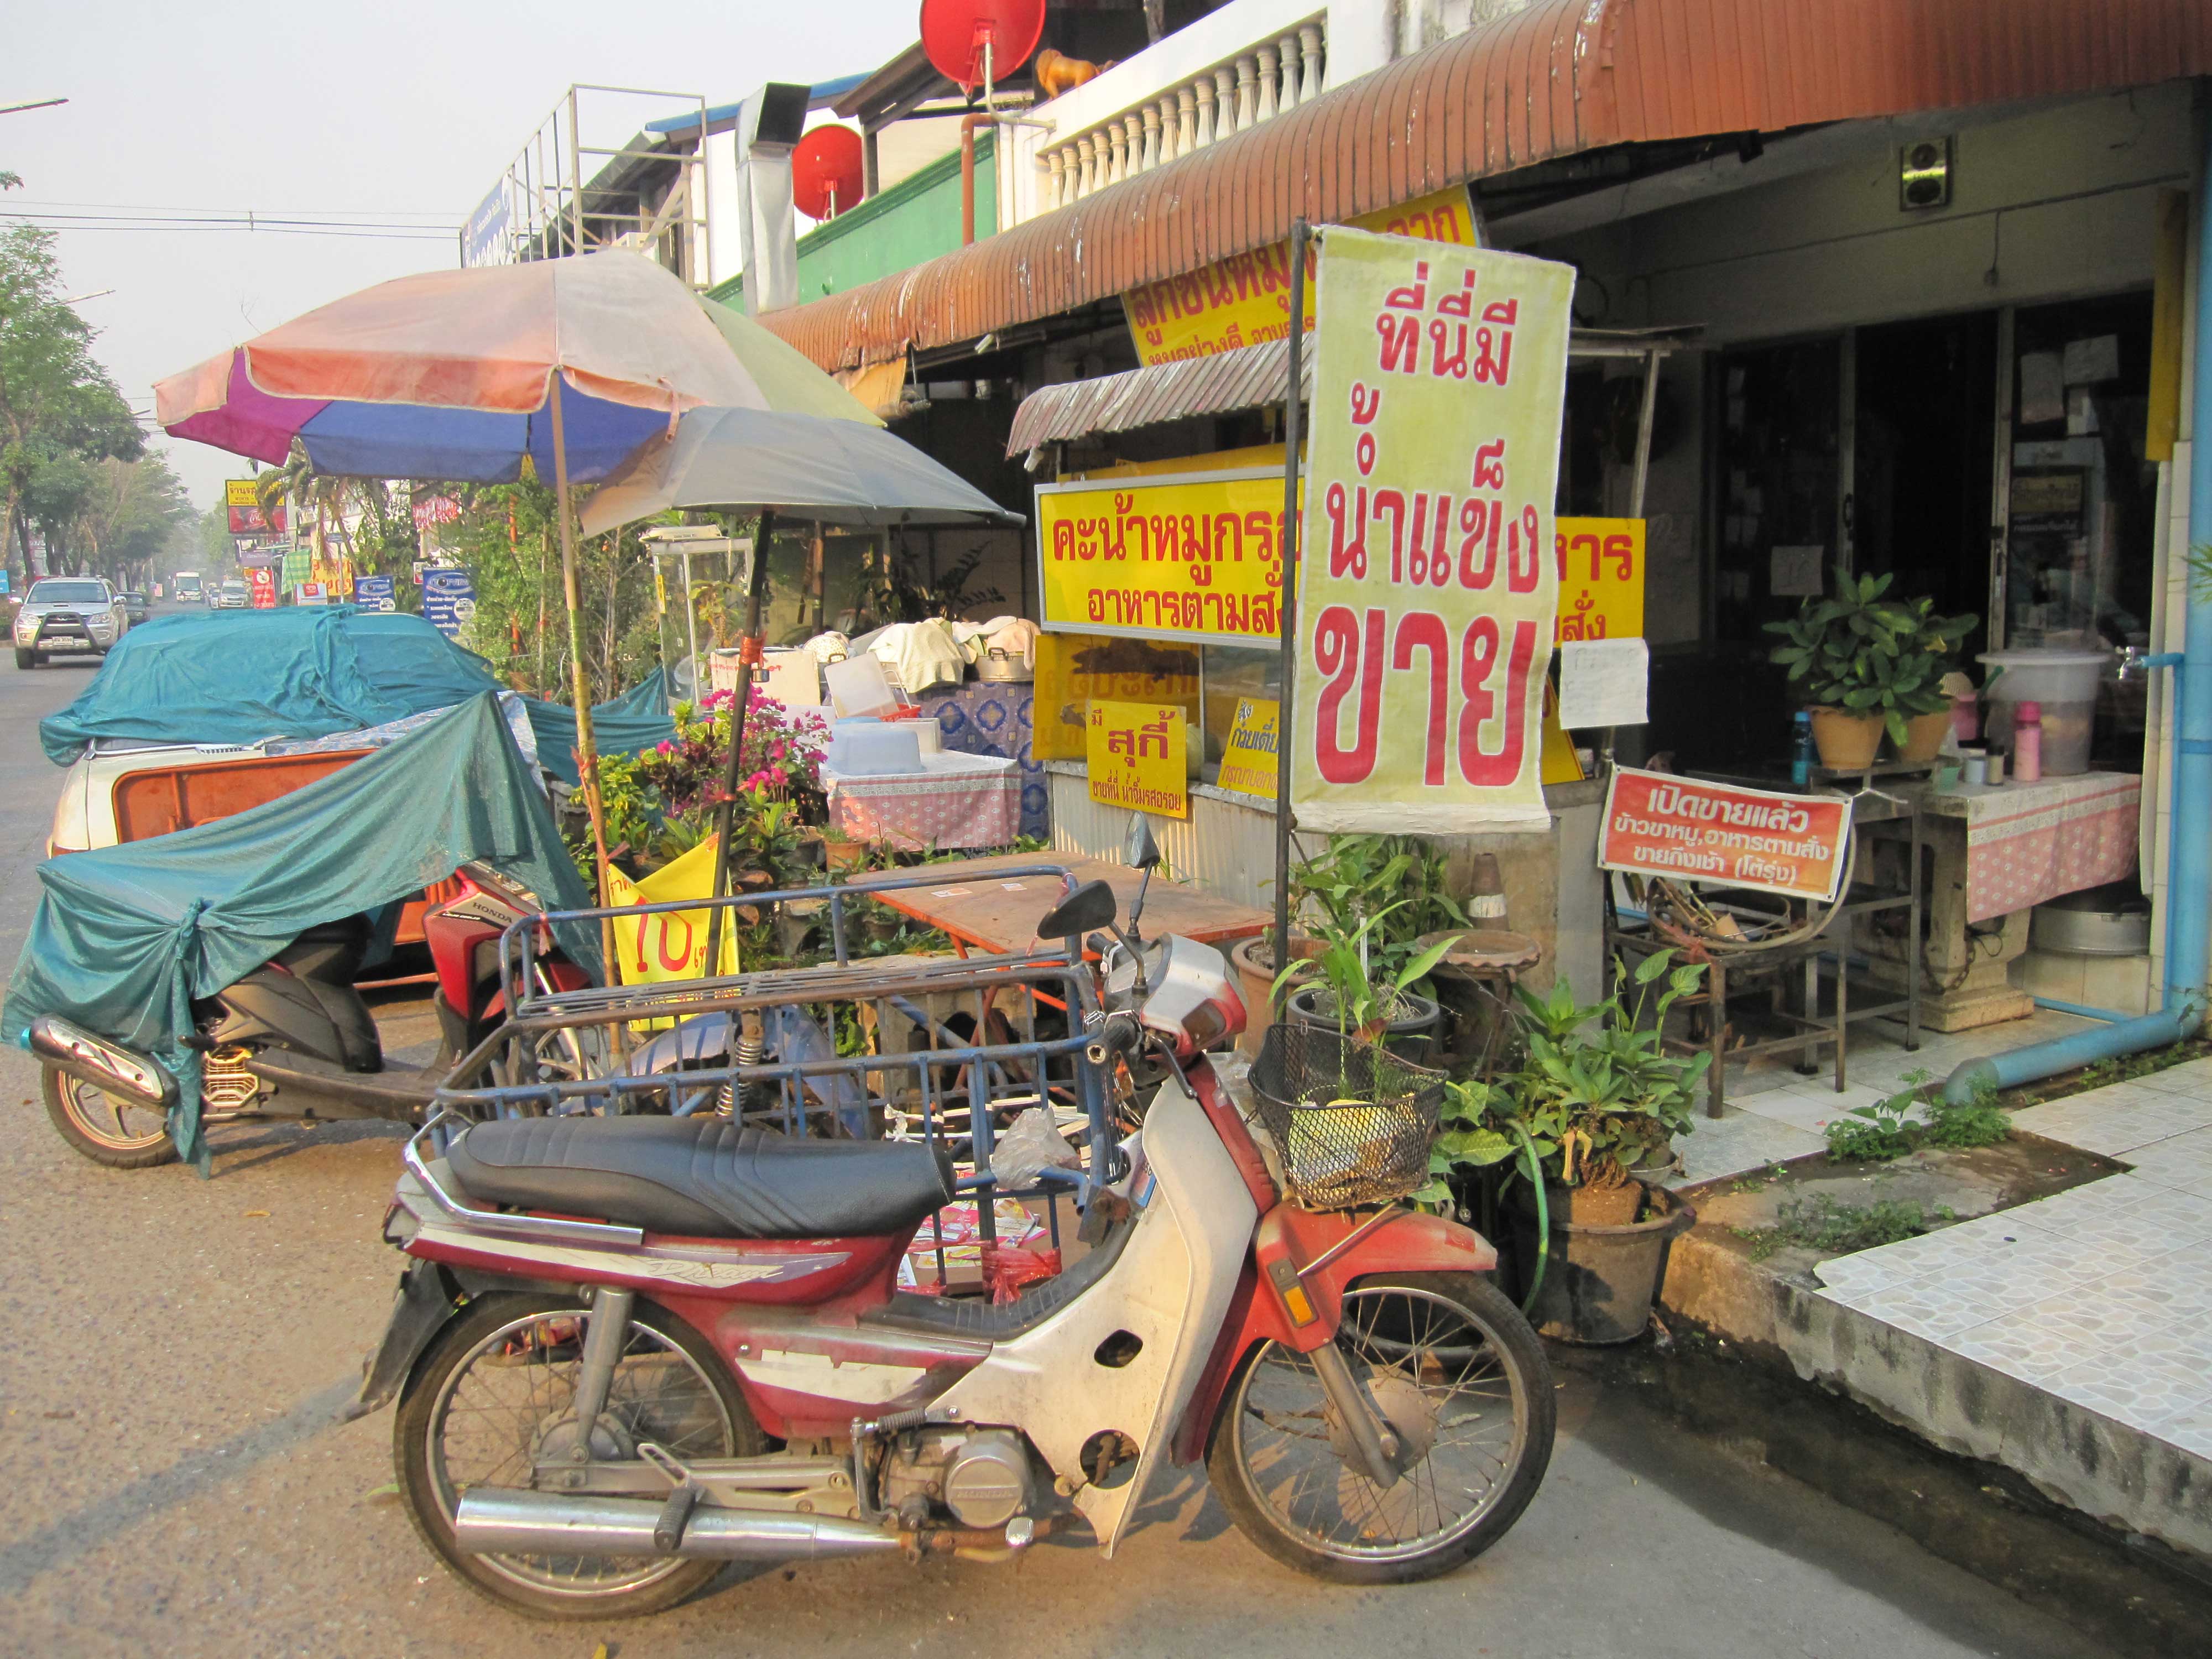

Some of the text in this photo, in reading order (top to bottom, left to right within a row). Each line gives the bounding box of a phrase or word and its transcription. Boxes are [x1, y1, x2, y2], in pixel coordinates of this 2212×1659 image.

[1376, 261, 1519, 387] ที่นี่มี
[1326, 382, 1541, 594] น้ำแข็ง
[1091, 708, 1103, 726] มี
[1314, 605, 1537, 787] ขาย
[1108, 710, 1176, 768] สุกี้
[1093, 769, 1120, 800] ขายที่นี่
[1647, 784, 1809, 833] เปิดขายแล้ว
[1734, 854, 1797, 886] (โต้รุ่ง)
[473, 901, 513, 924] HONDA
